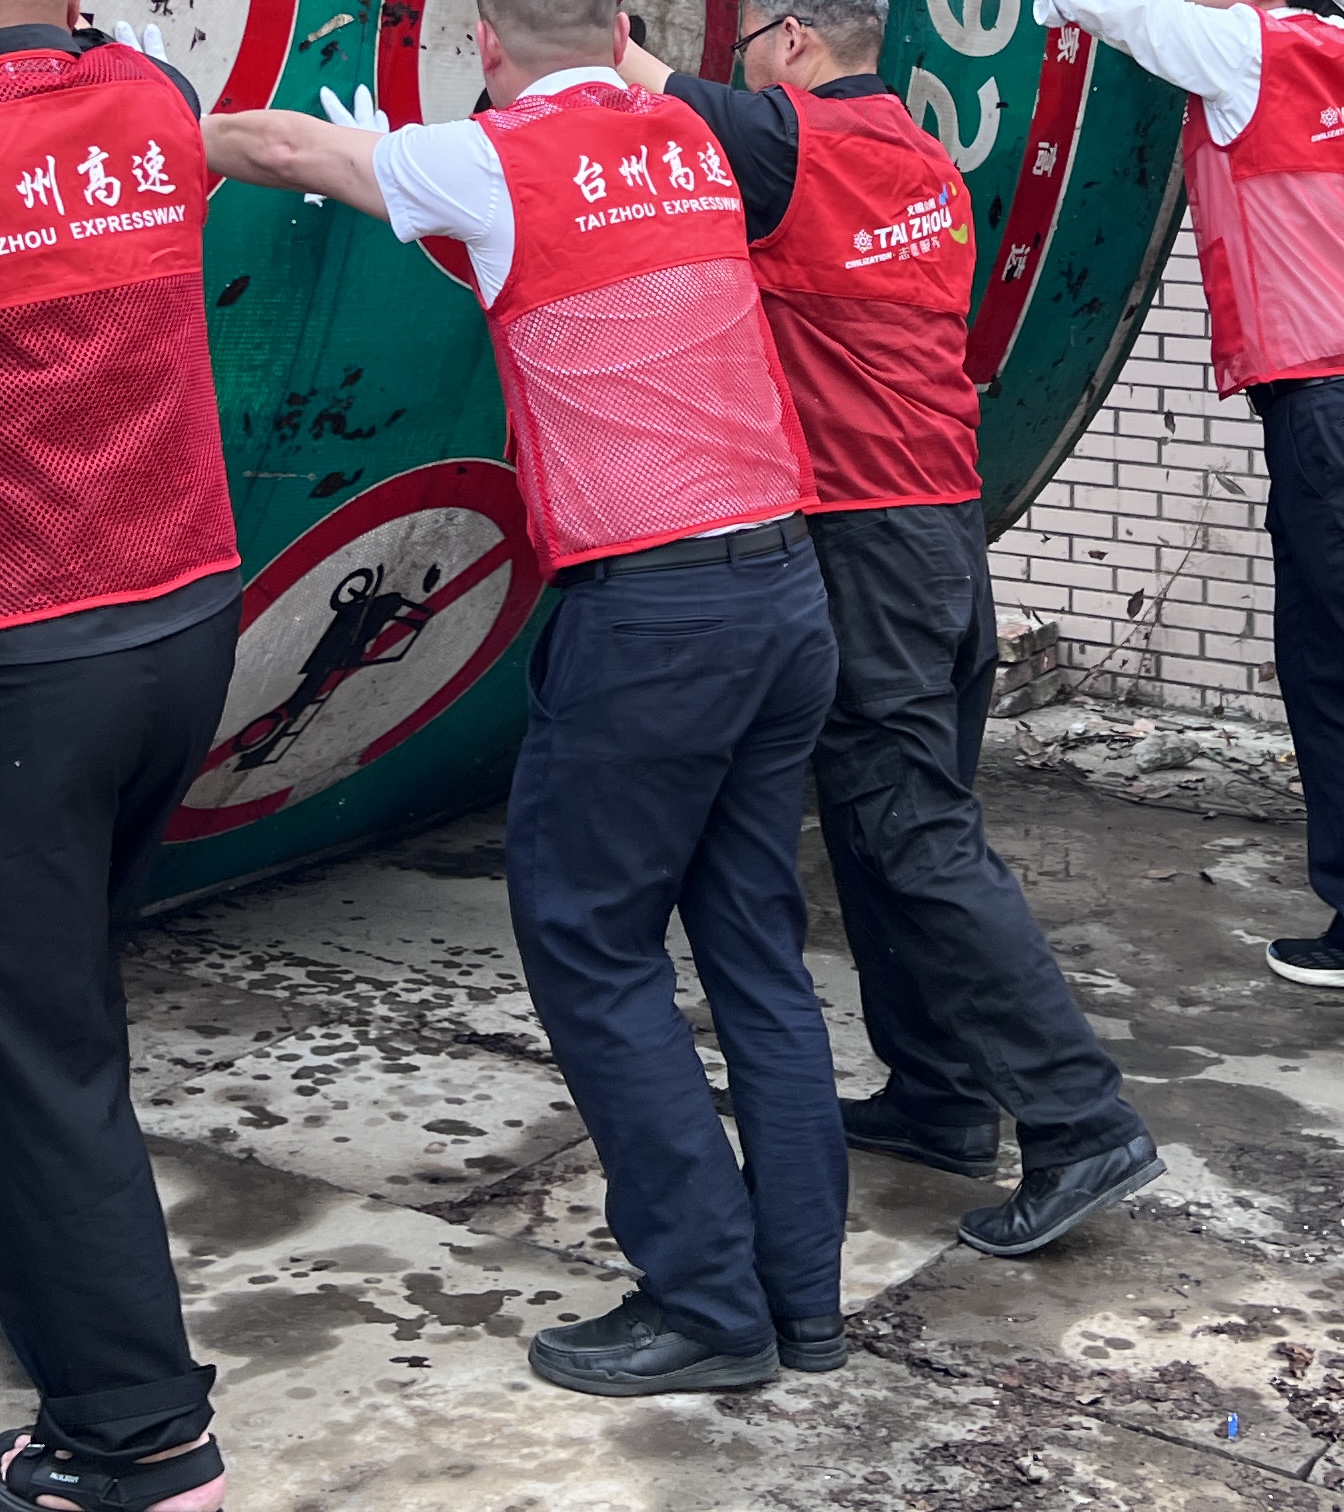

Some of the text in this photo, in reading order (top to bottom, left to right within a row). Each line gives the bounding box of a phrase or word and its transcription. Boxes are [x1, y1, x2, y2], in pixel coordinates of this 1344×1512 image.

[573, 140, 733, 203] 台州高速
[69, 204, 186, 240] EXPRESSWAY
